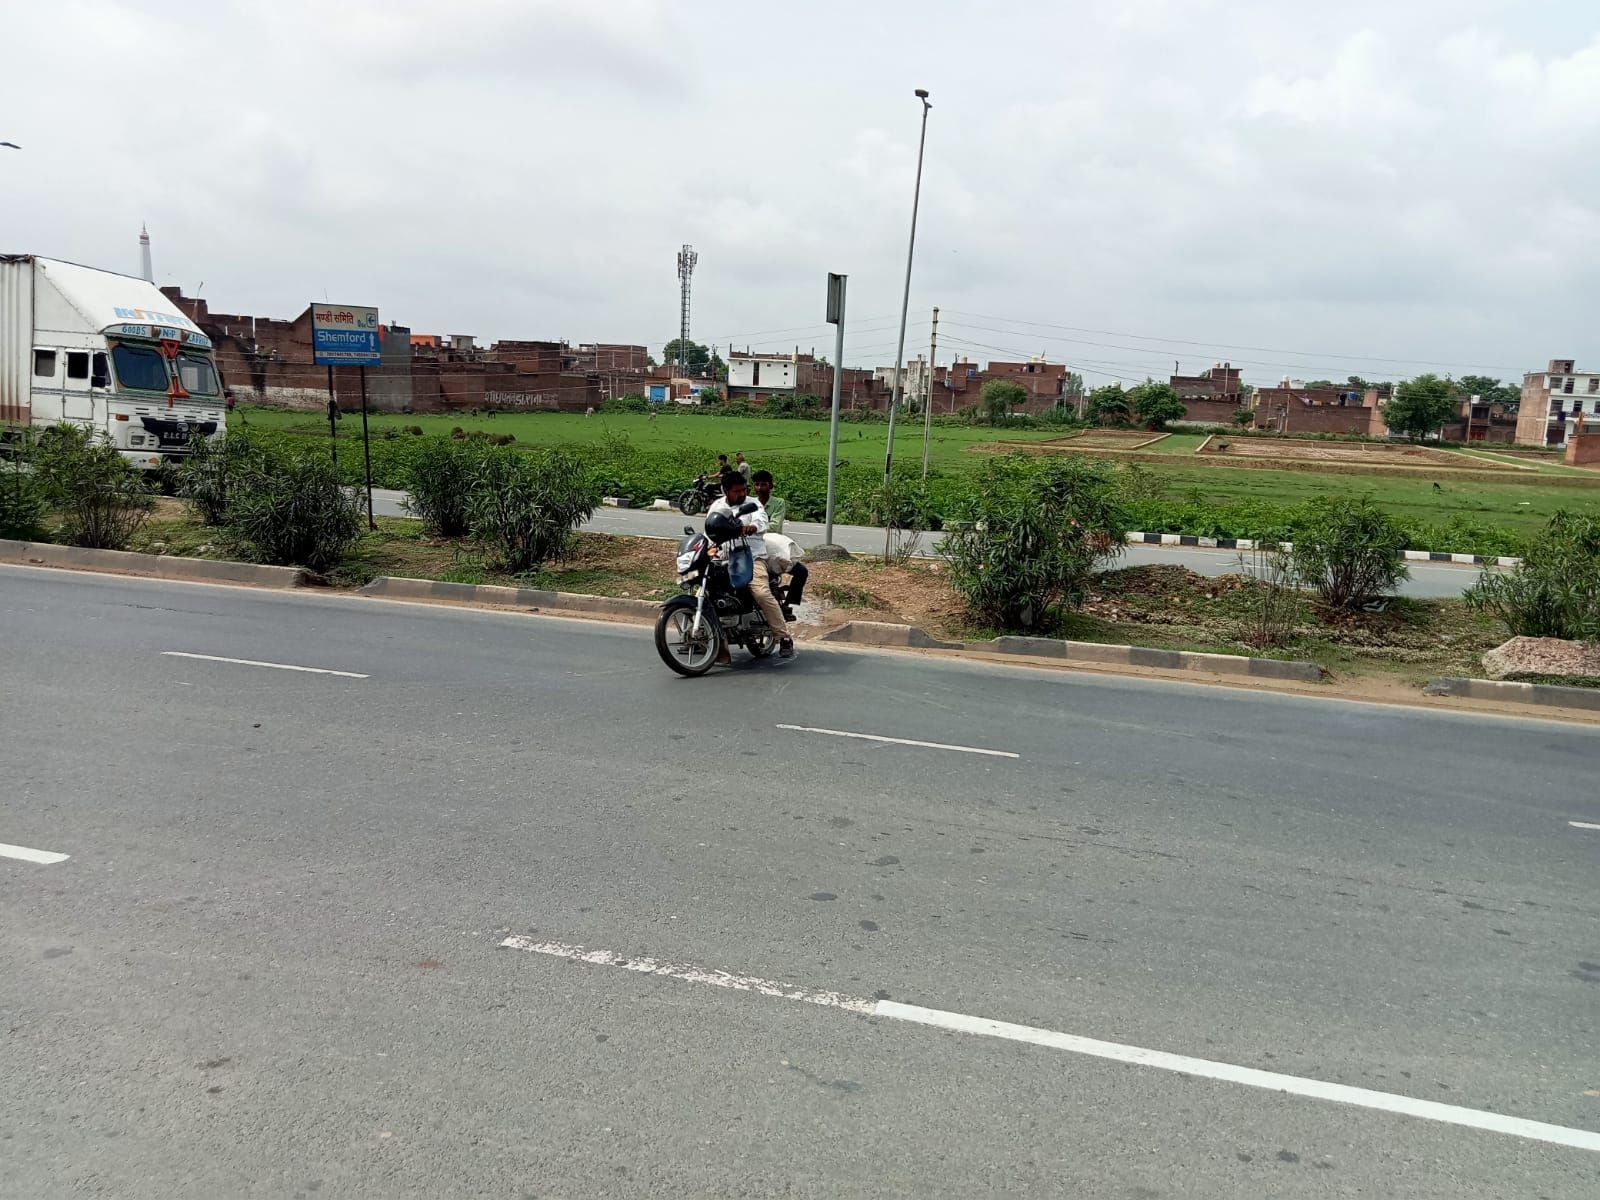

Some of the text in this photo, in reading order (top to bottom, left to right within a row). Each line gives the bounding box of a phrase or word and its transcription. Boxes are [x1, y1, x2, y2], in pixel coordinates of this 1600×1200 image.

[333, 311, 354, 325] समिति
[122, 326, 146, 335] GOODS
[317, 330, 366, 343] Shemford
